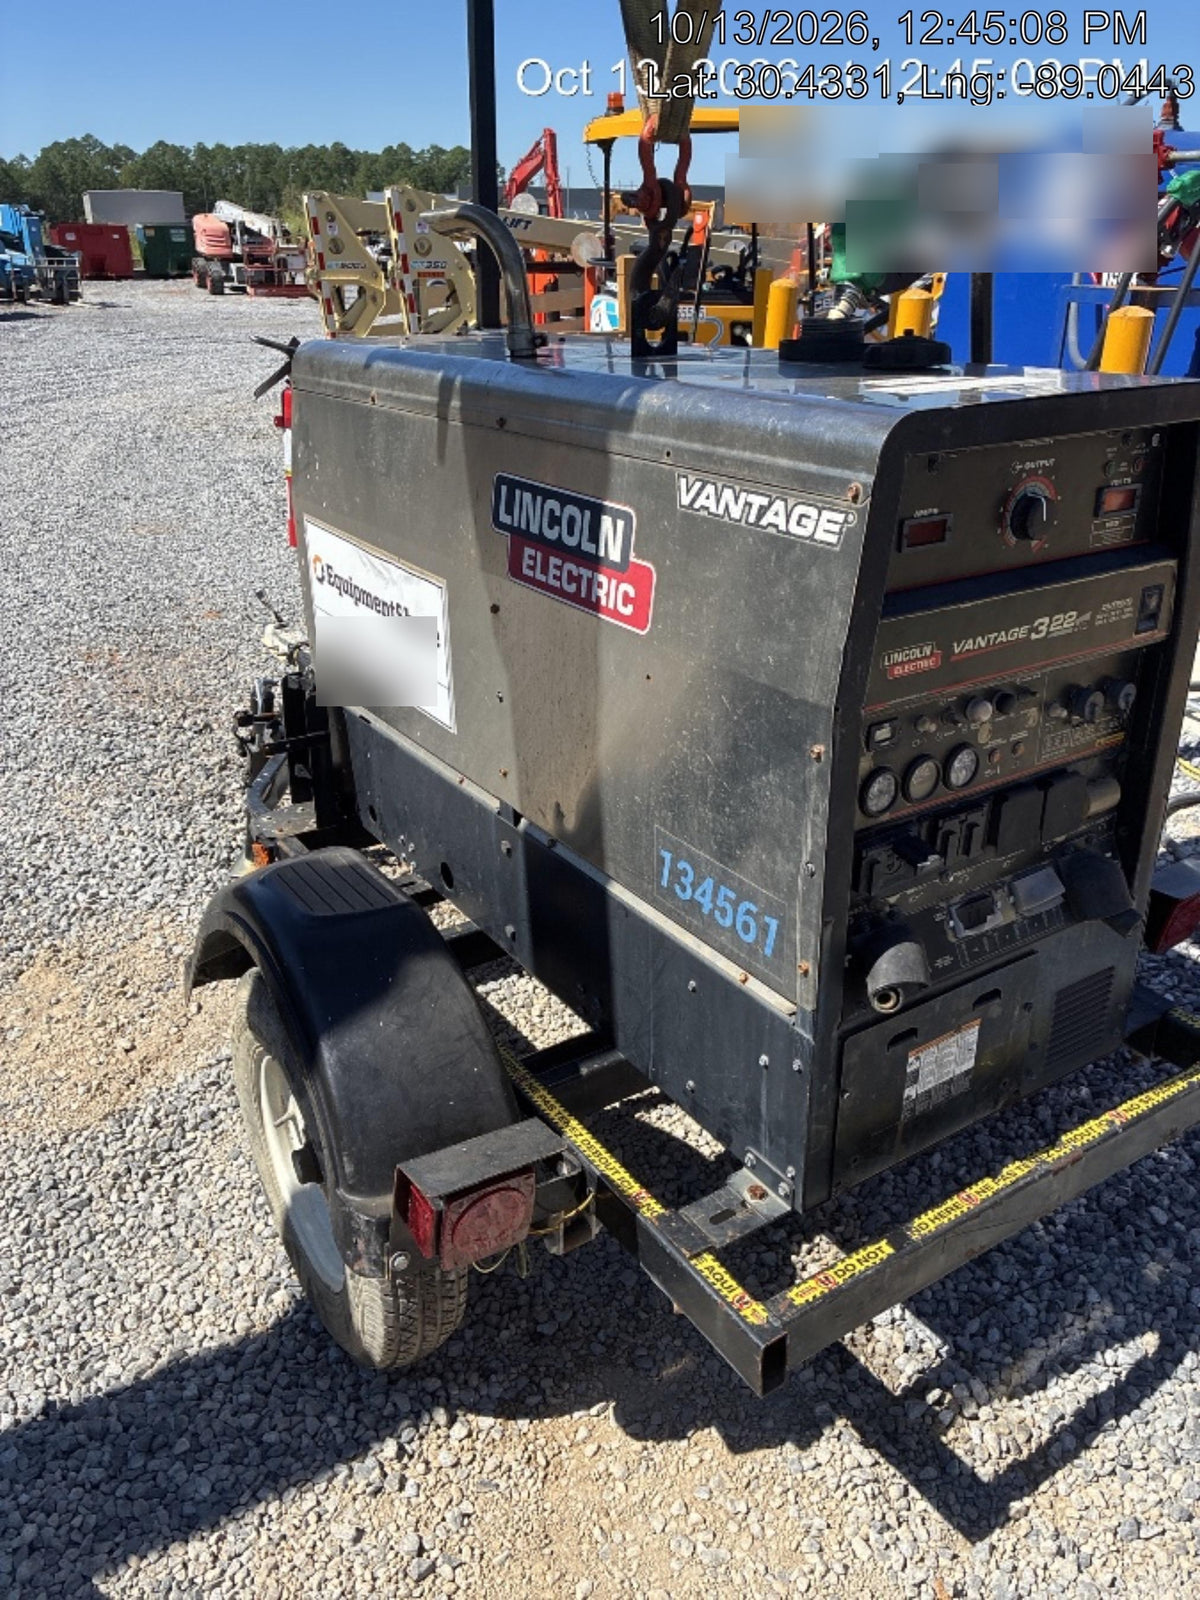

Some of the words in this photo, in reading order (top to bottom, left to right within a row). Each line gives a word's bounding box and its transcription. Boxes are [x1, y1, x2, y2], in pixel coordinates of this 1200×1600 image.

[499, 484, 625, 563] LINCOLN
[677, 475, 846, 546] VANTAGE
[521, 547, 636, 616] ELECTRIC
[952, 626, 1030, 655] VANTAGE
[1031, 610, 1078, 641] 322
[884, 645, 932, 666] LINCOLN
[581, 1138, 621, 1176] DEBOUT
[929, 1201, 963, 1224] HERE
[834, 1262, 857, 1278] DO
[856, 1245, 886, 1267] NOT
